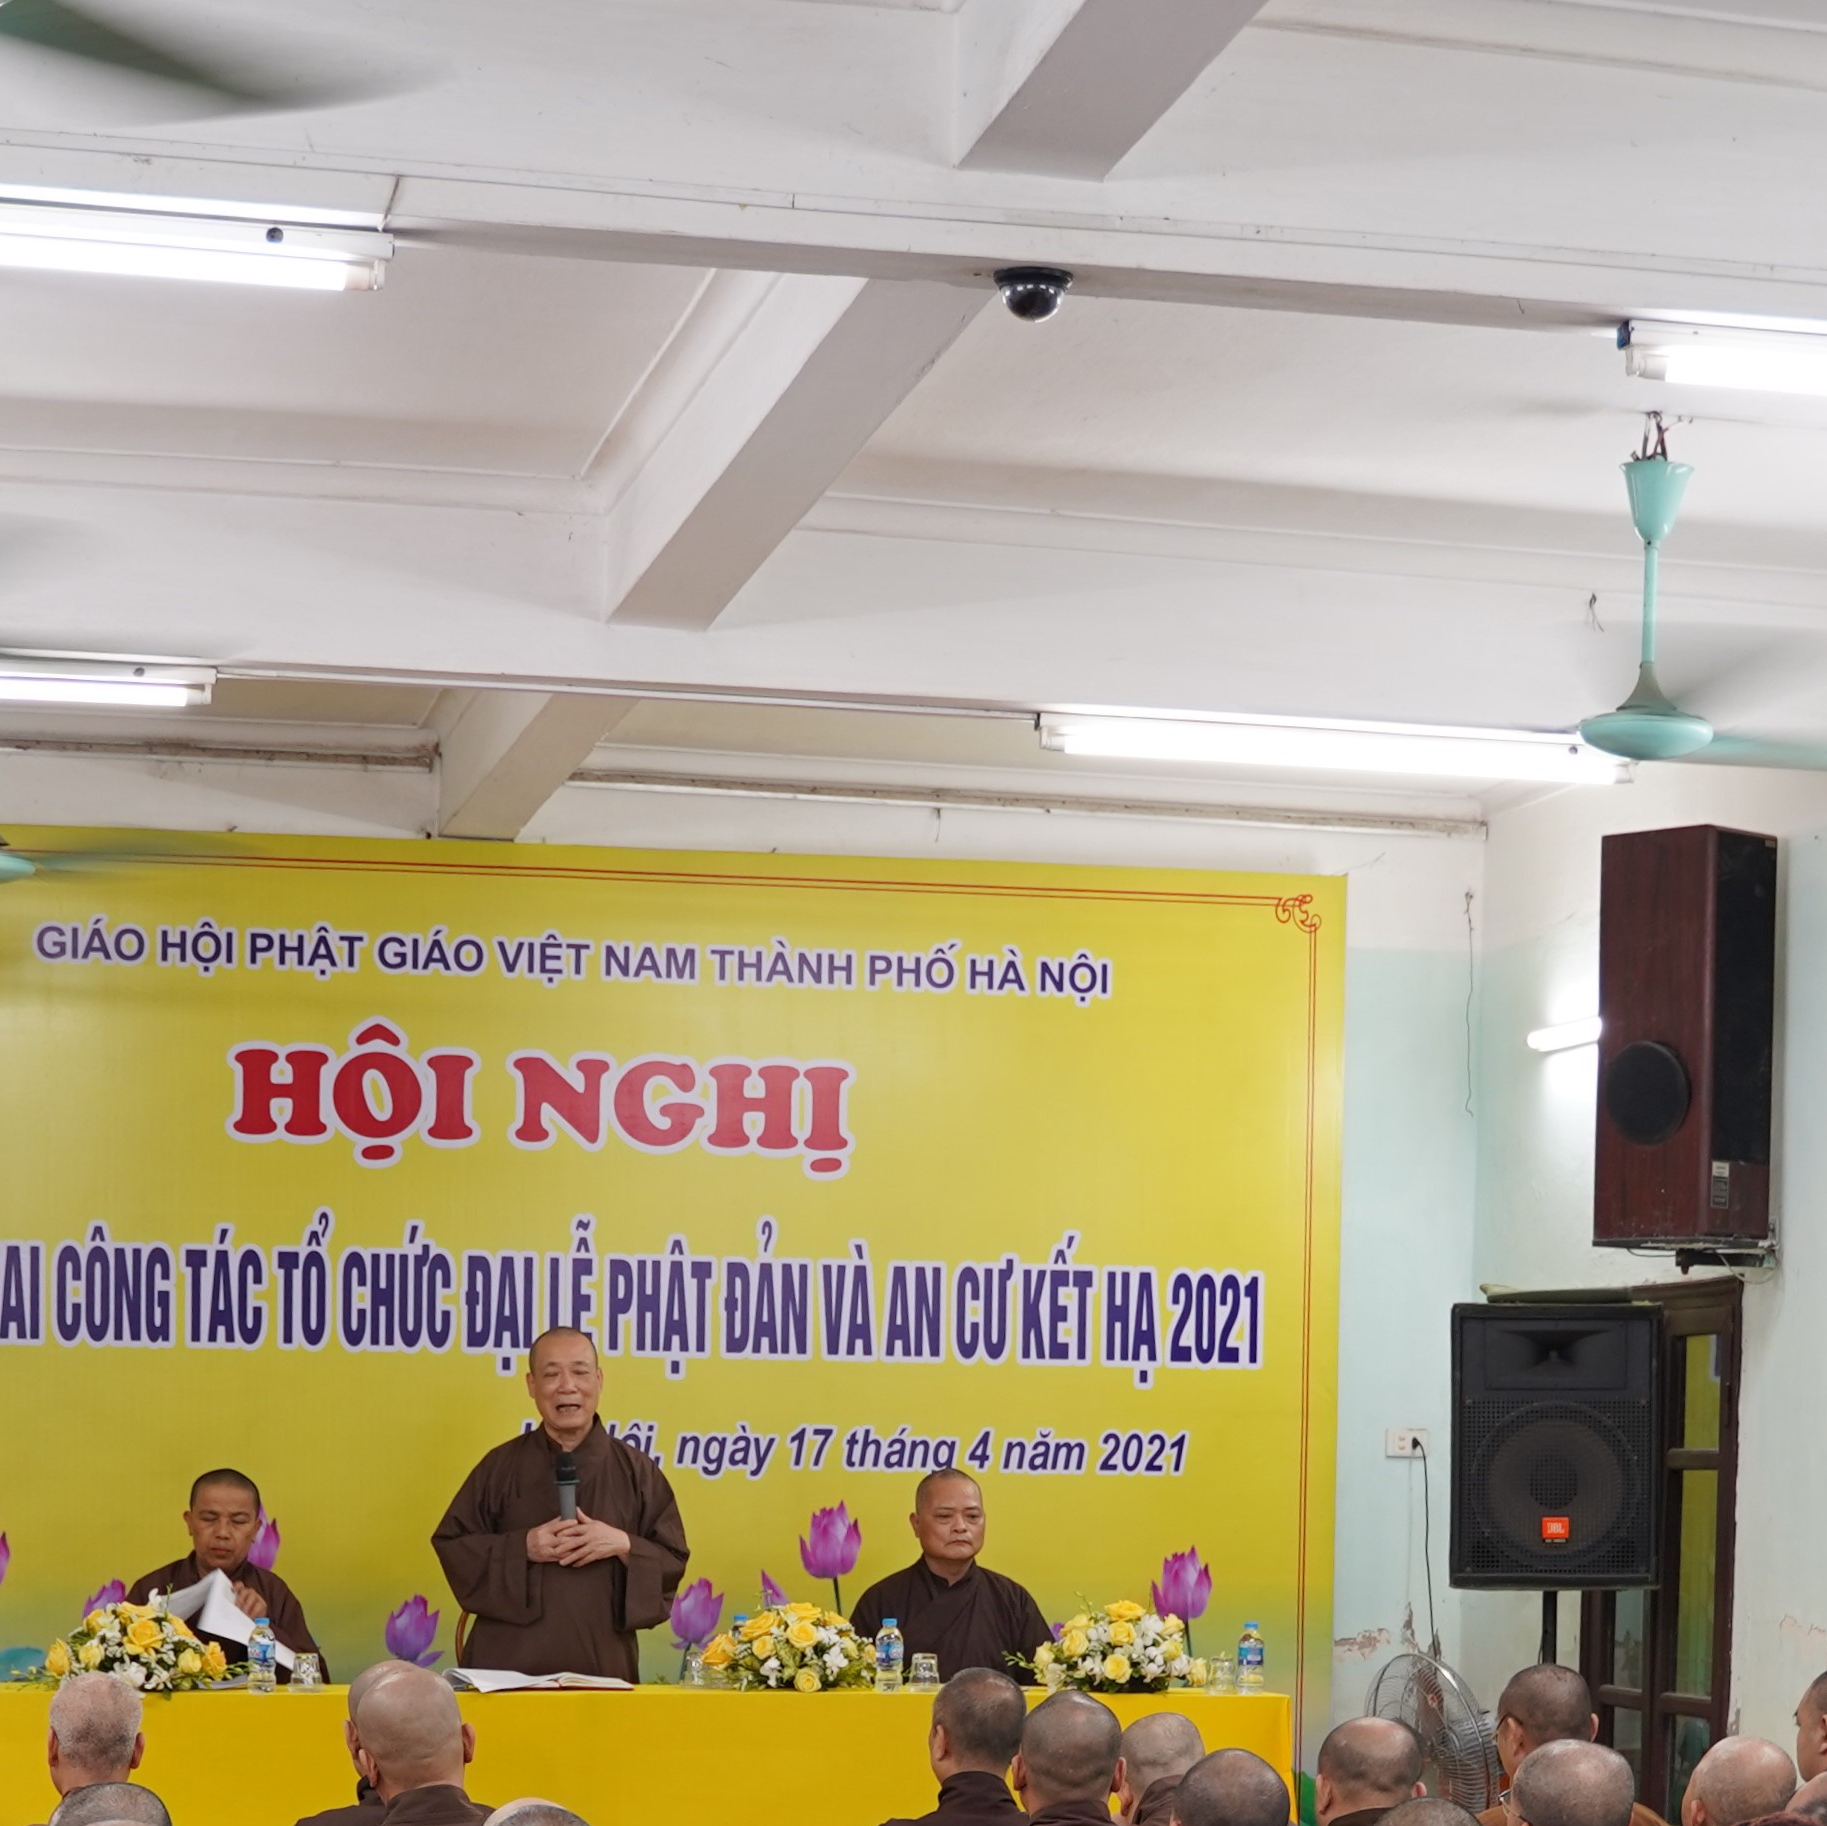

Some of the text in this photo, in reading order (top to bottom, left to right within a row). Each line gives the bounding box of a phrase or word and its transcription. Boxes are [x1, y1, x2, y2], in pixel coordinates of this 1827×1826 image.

[37, 919, 1107, 1001] GIÁO HỘI PHẬT GIÁO VIỆT NAM THÀNH PHỐ HÀ NỘI
[233, 1023, 848, 1173] HỘI NGHỊ
[56, 1226, 171, 1344] CÔNG
[185, 1229, 263, 1345] TÁC
[277, 1212, 330, 1347] TỔ
[341, 1225, 452, 1349] CHỨC
[465, 1254, 534, 1371] ĐẠI
[608, 1239, 712, 1375] PHẬT
[724, 1220, 808, 1355] ĐẢN
[822, 1241, 873, 1356] VÀ
[885, 1266, 941, 1358] AN
[956, 1258, 1014, 1360] CƯ
[1021, 1235, 1093, 1361] KẾT
[1106, 1271, 1157, 1384] HẠ
[1170, 1272, 1259, 1365] 2021
[676, 1425, 776, 1477] ngày
[789, 1428, 834, 1467] 17
[845, 1428, 956, 1474] tháng
[968, 1431, 991, 1469] 4
[1002, 1432, 1085, 1471] năm
[1099, 1432, 1186, 1474] 2021
